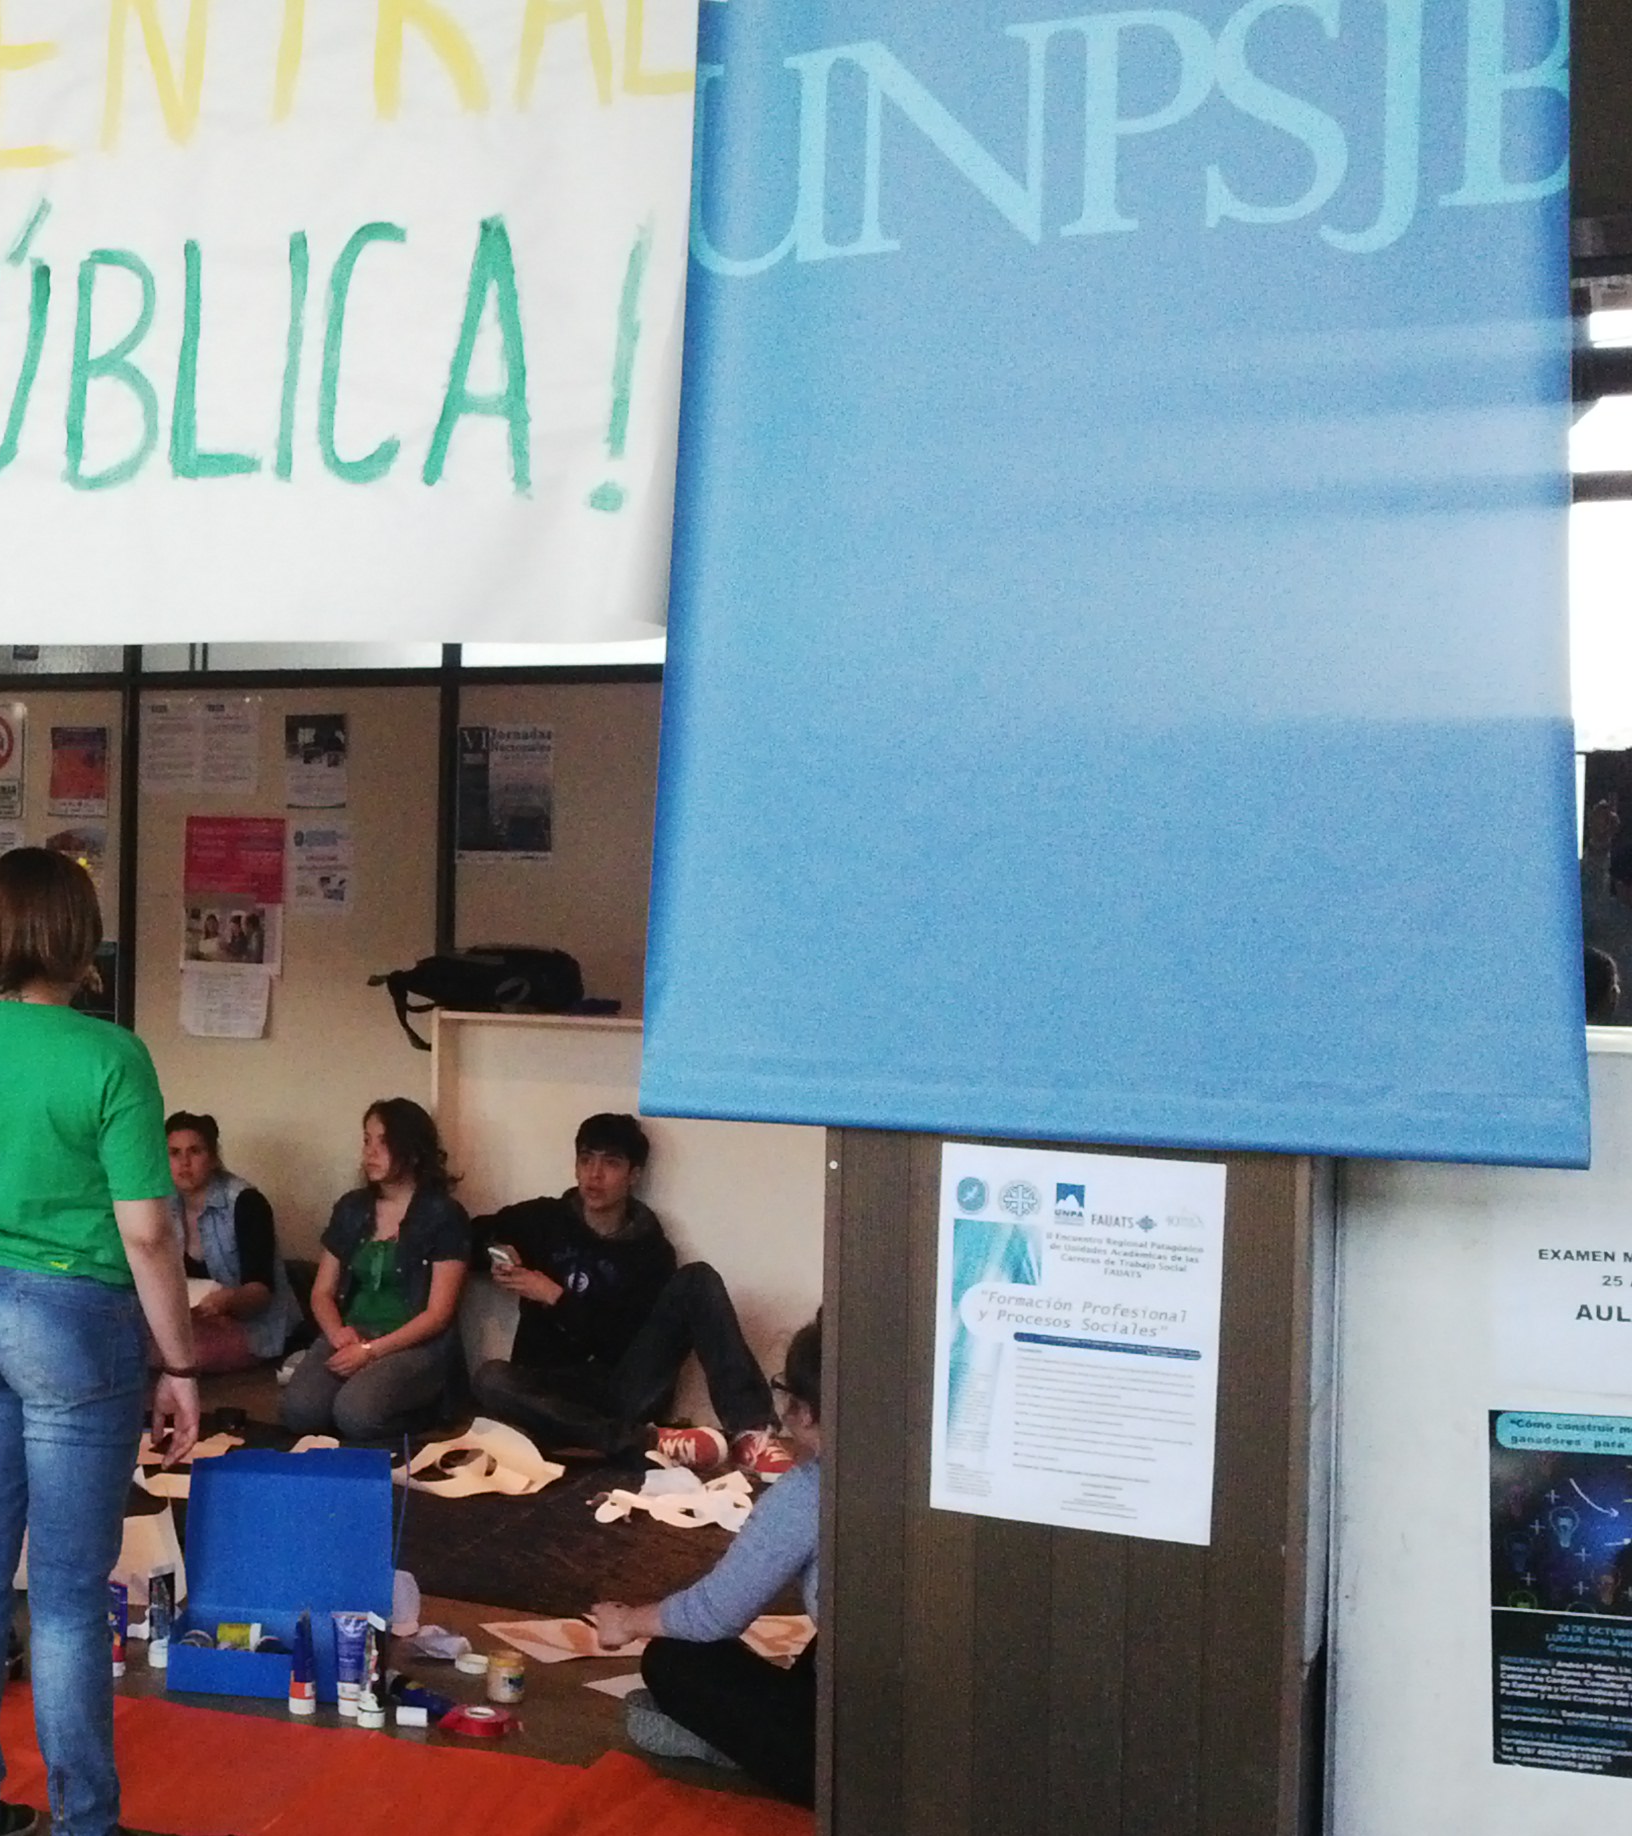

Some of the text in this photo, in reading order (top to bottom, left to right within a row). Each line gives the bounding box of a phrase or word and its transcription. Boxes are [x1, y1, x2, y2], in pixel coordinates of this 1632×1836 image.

[1055, 1209, 1084, 1218] UNPA
[1090, 1214, 1134, 1229] FAUATS
[1055, 1232, 1103, 1245] Encuentro
[1106, 1237, 1148, 1249] Regional
[1064, 1244, 1107, 1256] Unidades
[1171, 1254, 1182, 1263] de
[1185, 1255, 1199, 1264] las
[1538, 1249, 1616, 1262] EXAMEN
[1060, 1253, 1187, 1273] Carreras de Trabajo Social
[1602, 1275, 1623, 1287] 25
[1082, 1300, 1188, 1323] Profesional
[977, 1308, 1168, 1338] y Procesos Sociales"
[1557, 1422, 1615, 1433] construir
[1510, 1435, 1625, 1449] ganadores para
